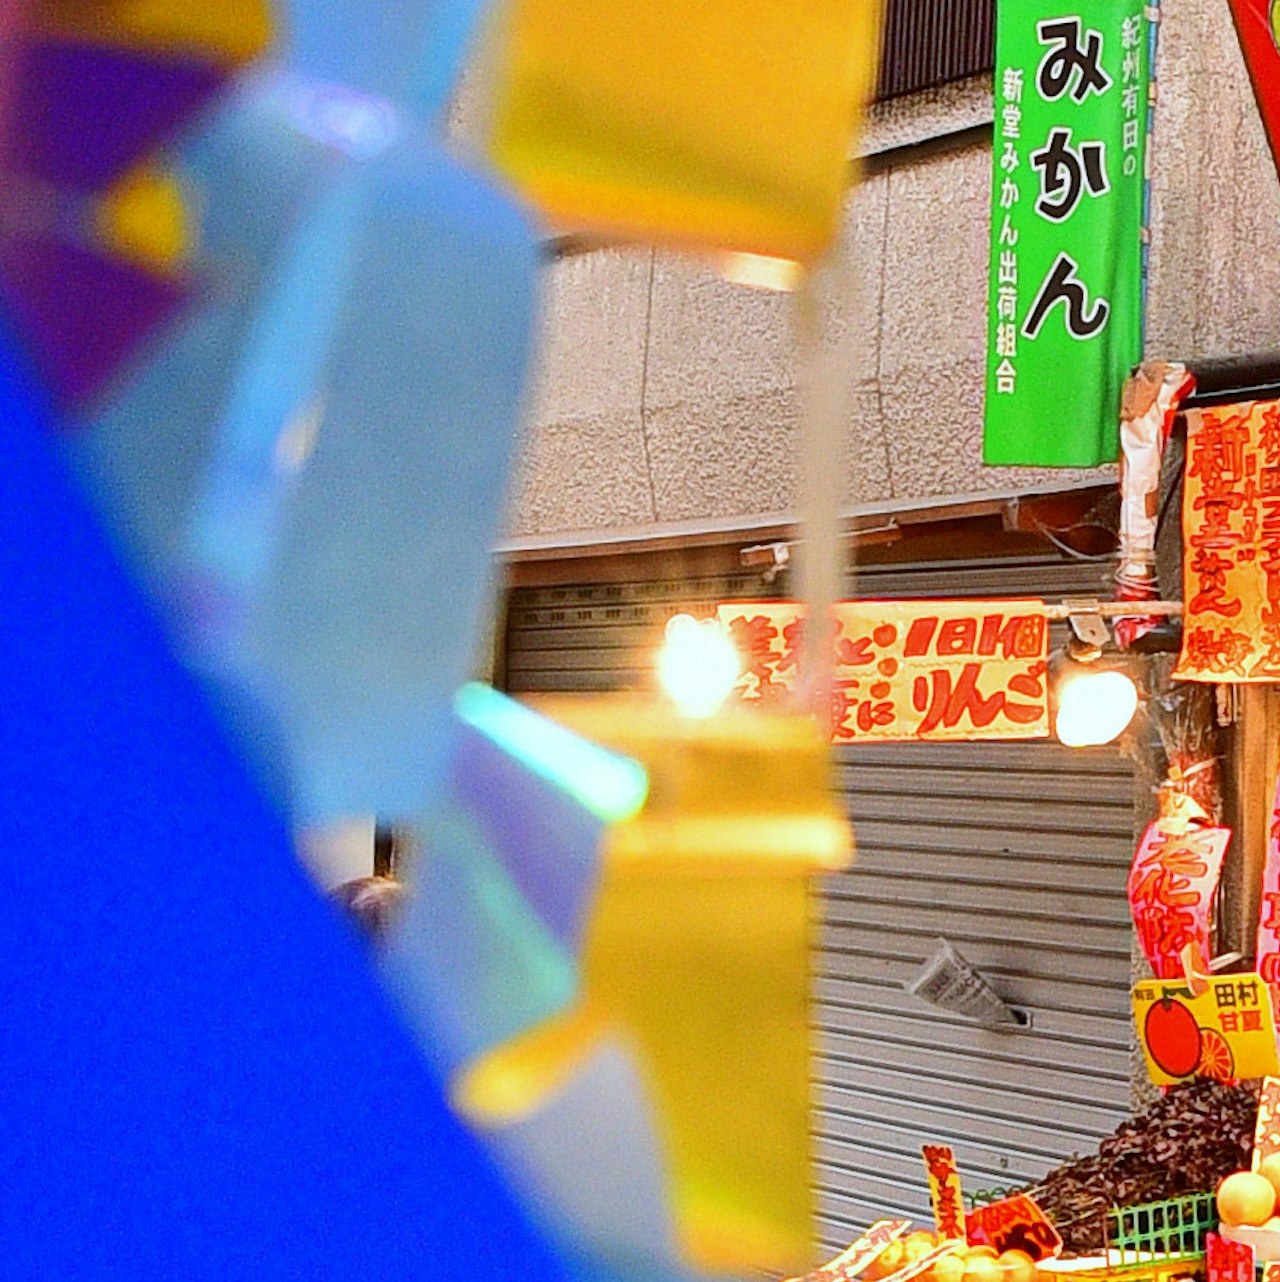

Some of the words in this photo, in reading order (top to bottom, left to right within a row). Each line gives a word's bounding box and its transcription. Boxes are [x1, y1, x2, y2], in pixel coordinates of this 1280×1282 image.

[994, 65, 1025, 396] 新堂みかん出荷組合
[1022, 16, 1112, 342] みかん
[912, 661, 1048, 739] りんご
[1214, 982, 1259, 1007] 田村
